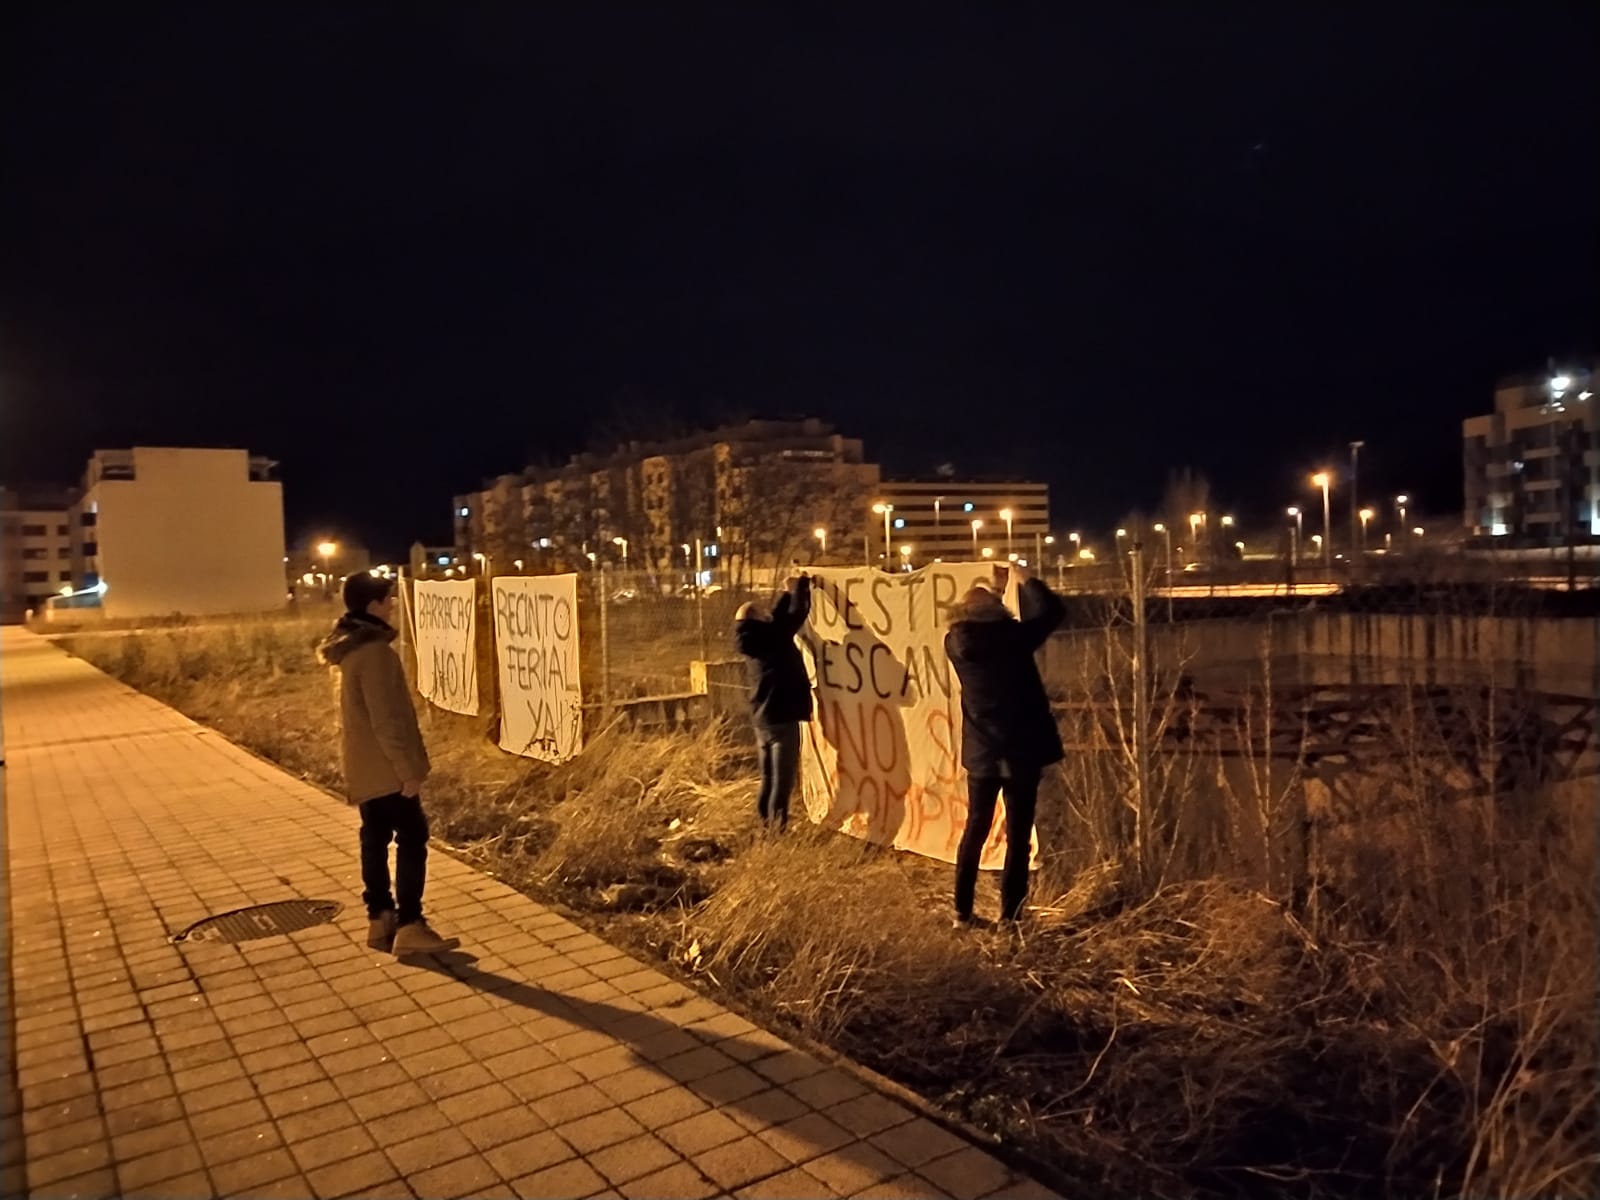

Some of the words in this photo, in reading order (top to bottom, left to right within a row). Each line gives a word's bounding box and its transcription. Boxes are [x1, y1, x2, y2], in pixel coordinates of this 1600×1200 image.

[495, 586, 572, 641] RECINTO
[505, 644, 580, 692] FERIAL
[832, 700, 898, 773] NO
